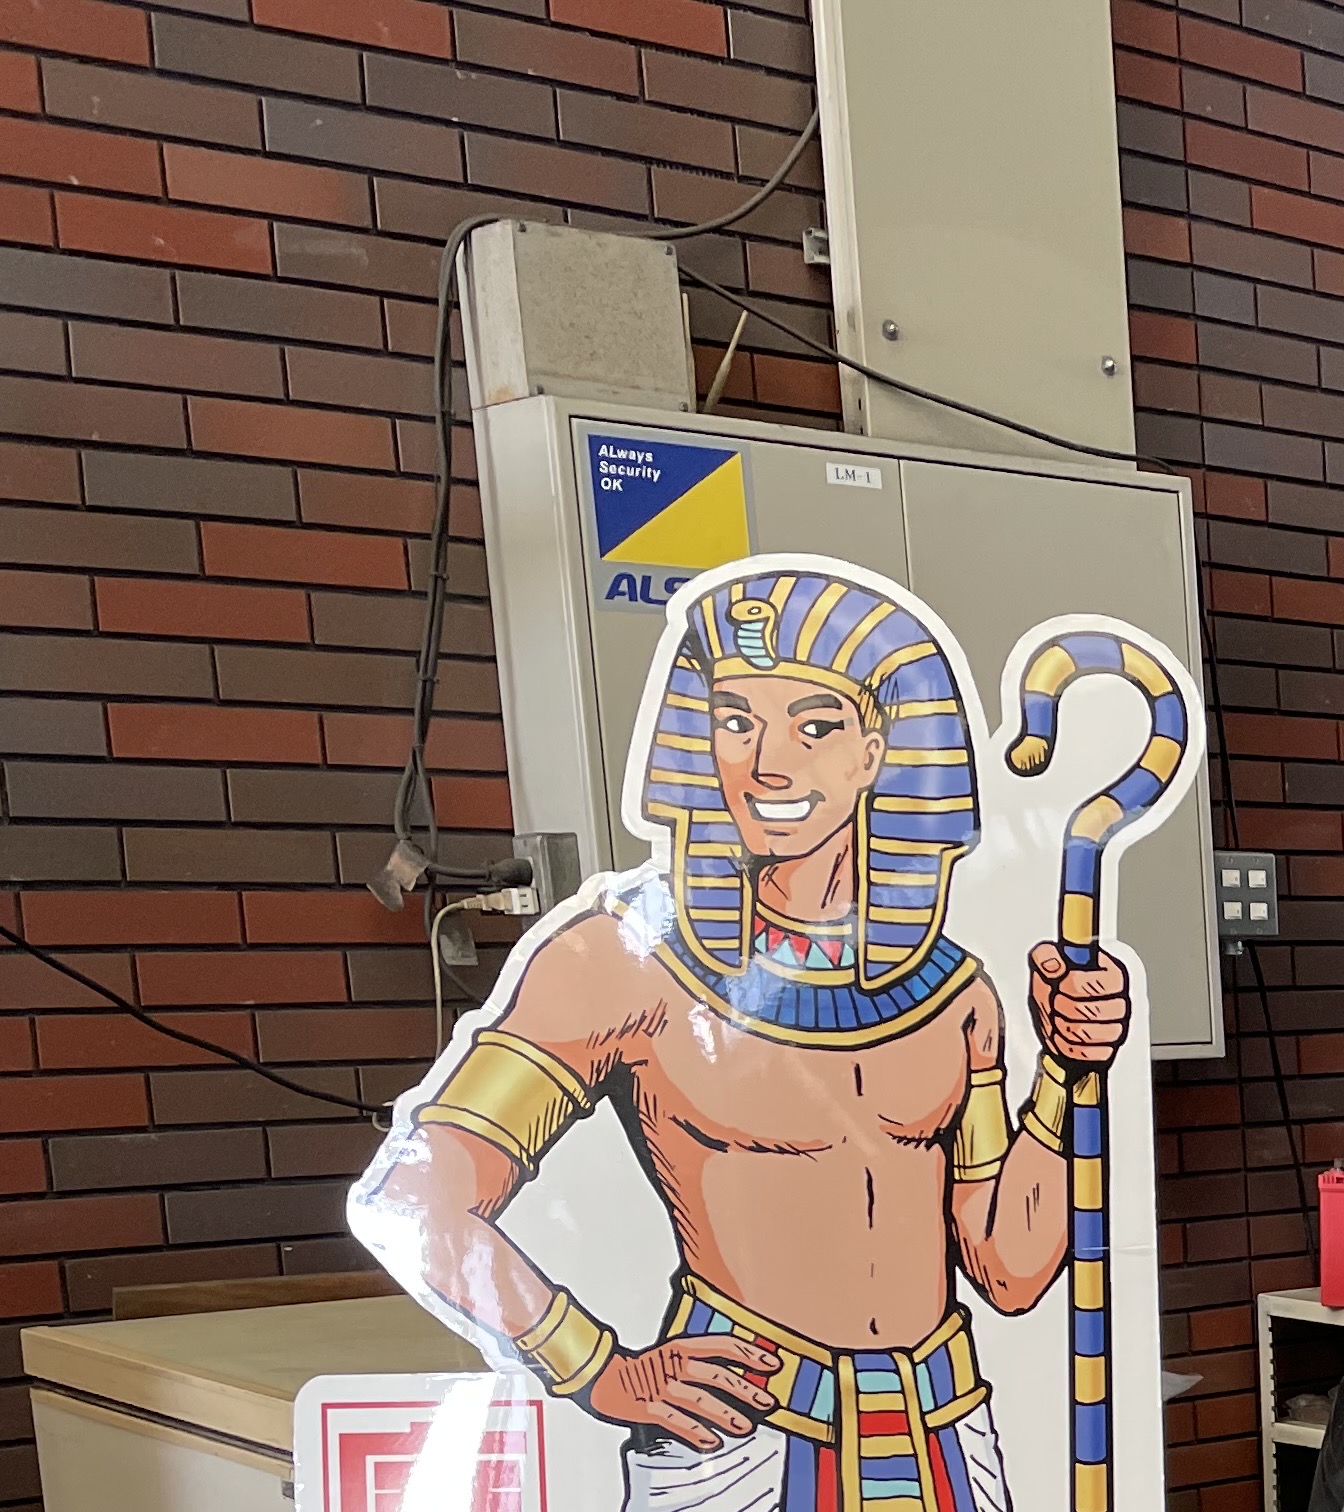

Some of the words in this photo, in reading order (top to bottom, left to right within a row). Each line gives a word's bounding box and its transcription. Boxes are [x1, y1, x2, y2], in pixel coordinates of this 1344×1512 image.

[598, 444, 653, 463] ALways
[599, 461, 661, 482] Security
[835, 467, 871, 484] LM-1
[600, 478, 623, 492] OK
